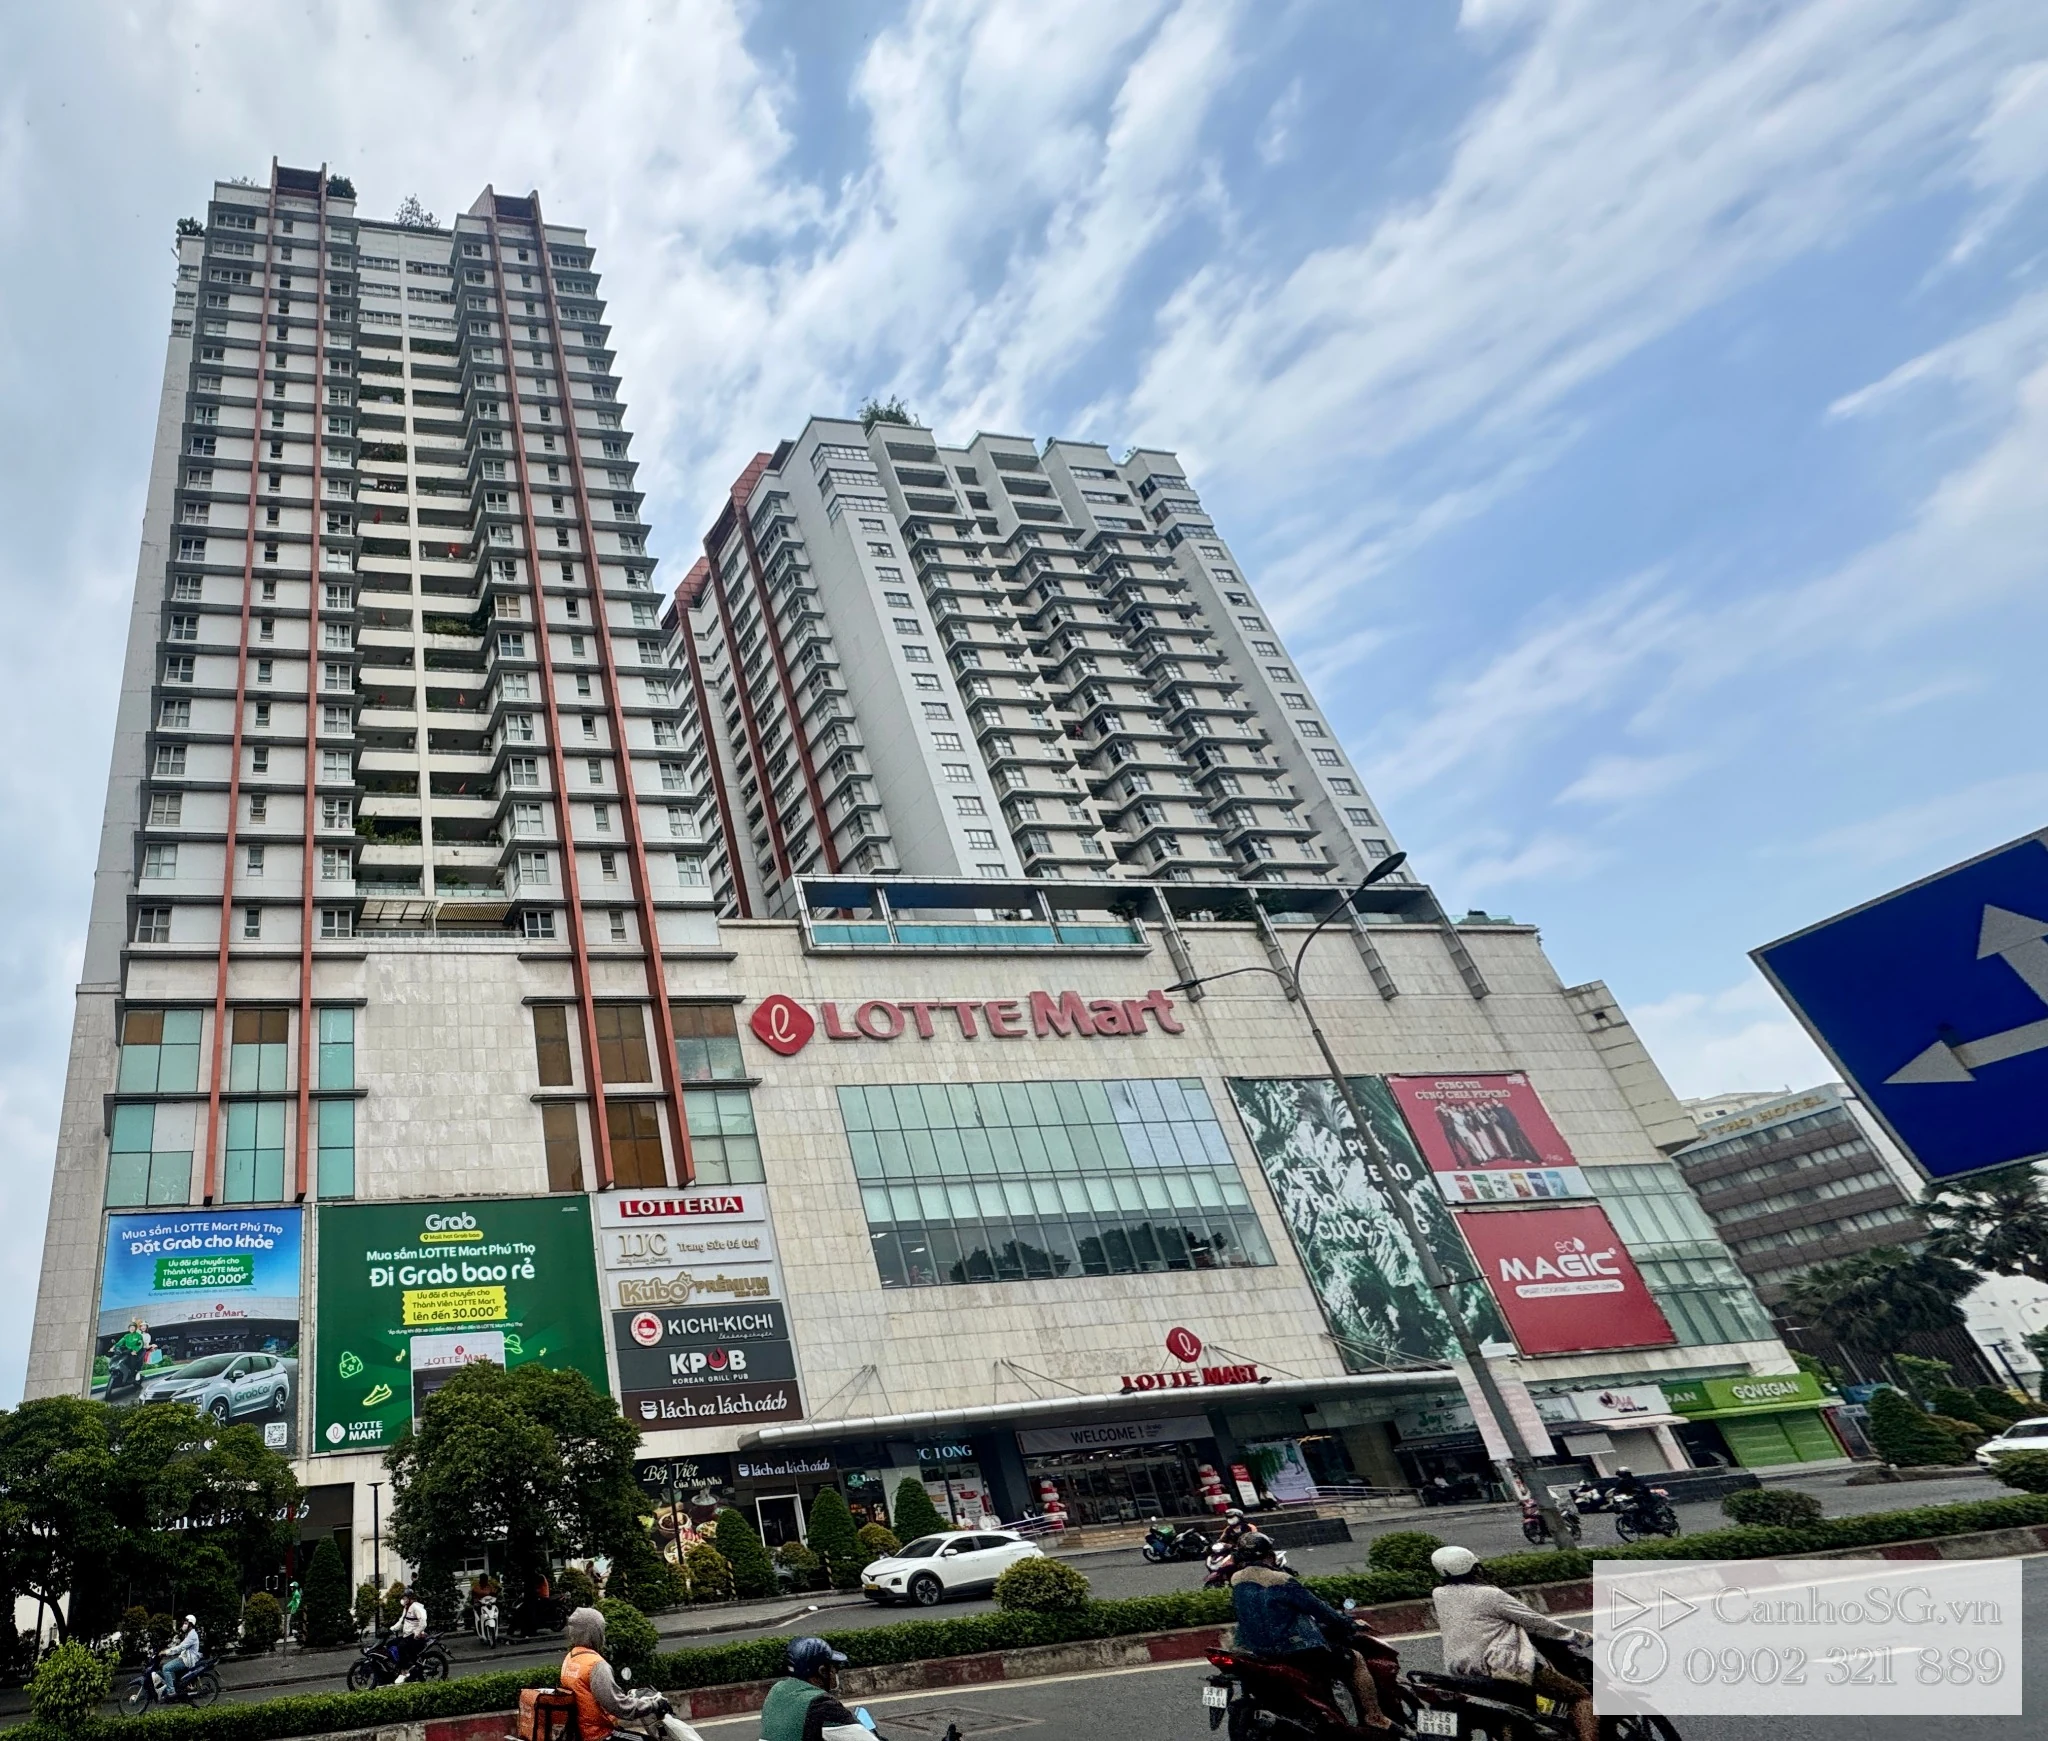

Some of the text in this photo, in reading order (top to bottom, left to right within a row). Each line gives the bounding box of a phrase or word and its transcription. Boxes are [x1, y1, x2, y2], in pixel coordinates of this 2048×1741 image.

[625, 1197, 740, 1216] LOTTERIA
[425, 1212, 476, 1231] Grab
[122, 1222, 283, 1240] Mua sắm LOTTE Mart Phú Thọ
[130, 1233, 274, 1256] Đặt Grab cho khỏe
[366, 1242, 536, 1261] Mua sắm LOTTE Mart Phú Thọ
[618, 1233, 668, 1258] LJC
[677, 1243, 705, 1253] Trang
[203, 1266, 226, 1274] LOTTE
[369, 1257, 535, 1287] Đi Grab bao rẻ
[1499, 1252, 1621, 1281] MAGIC
[162, 1278, 179, 1287] lên
[180, 1276, 199, 1286] đến
[412, 1301, 436, 1309] Thành
[454, 1298, 477, 1306] LOTTE
[222, 1309, 246, 1318] Mart
[413, 1311, 429, 1321] lên
[431, 1309, 450, 1320] đến
[667, 1313, 774, 1335] KICHI-KICHI
[427, 1356, 460, 1366] LOTTE
[672, 1377, 704, 1385] KOREAN
[733, 1373, 749, 1381] PUB
[1121, 1364, 1260, 1391] LOTTE MART
[235, 1385, 272, 1401] GrabCar
[660, 1390, 787, 1419] lách ca lách cách
[349, 1420, 383, 1430] LOTTE
[349, 1429, 383, 1441] MART
[1070, 1425, 1138, 1445] WELCOME
[672, 1459, 699, 1481] Việt
